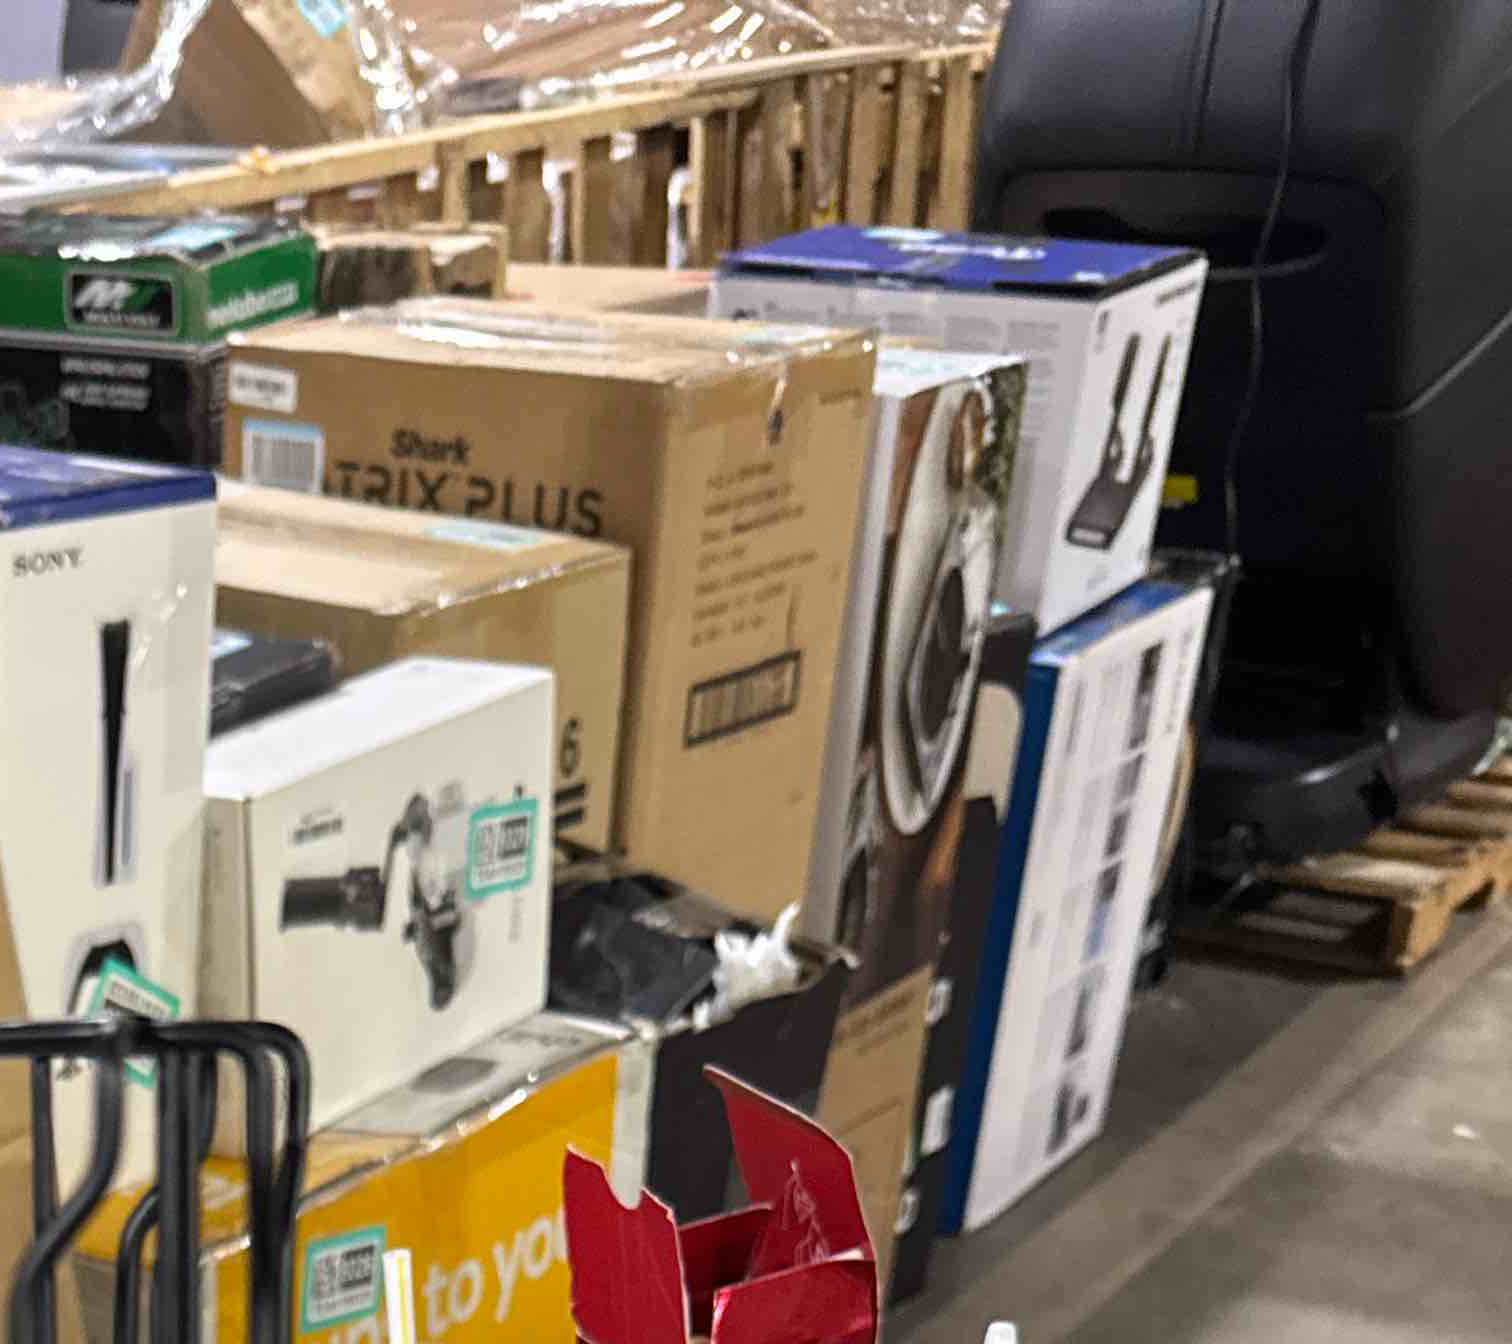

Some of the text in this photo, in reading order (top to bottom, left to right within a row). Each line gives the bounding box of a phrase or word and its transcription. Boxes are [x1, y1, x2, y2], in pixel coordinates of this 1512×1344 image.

[390, 428, 472, 465] Shark
[464, 475, 605, 539] PLUS
[11, 546, 85, 578] SONY
[423, 1257, 485, 1338] to
